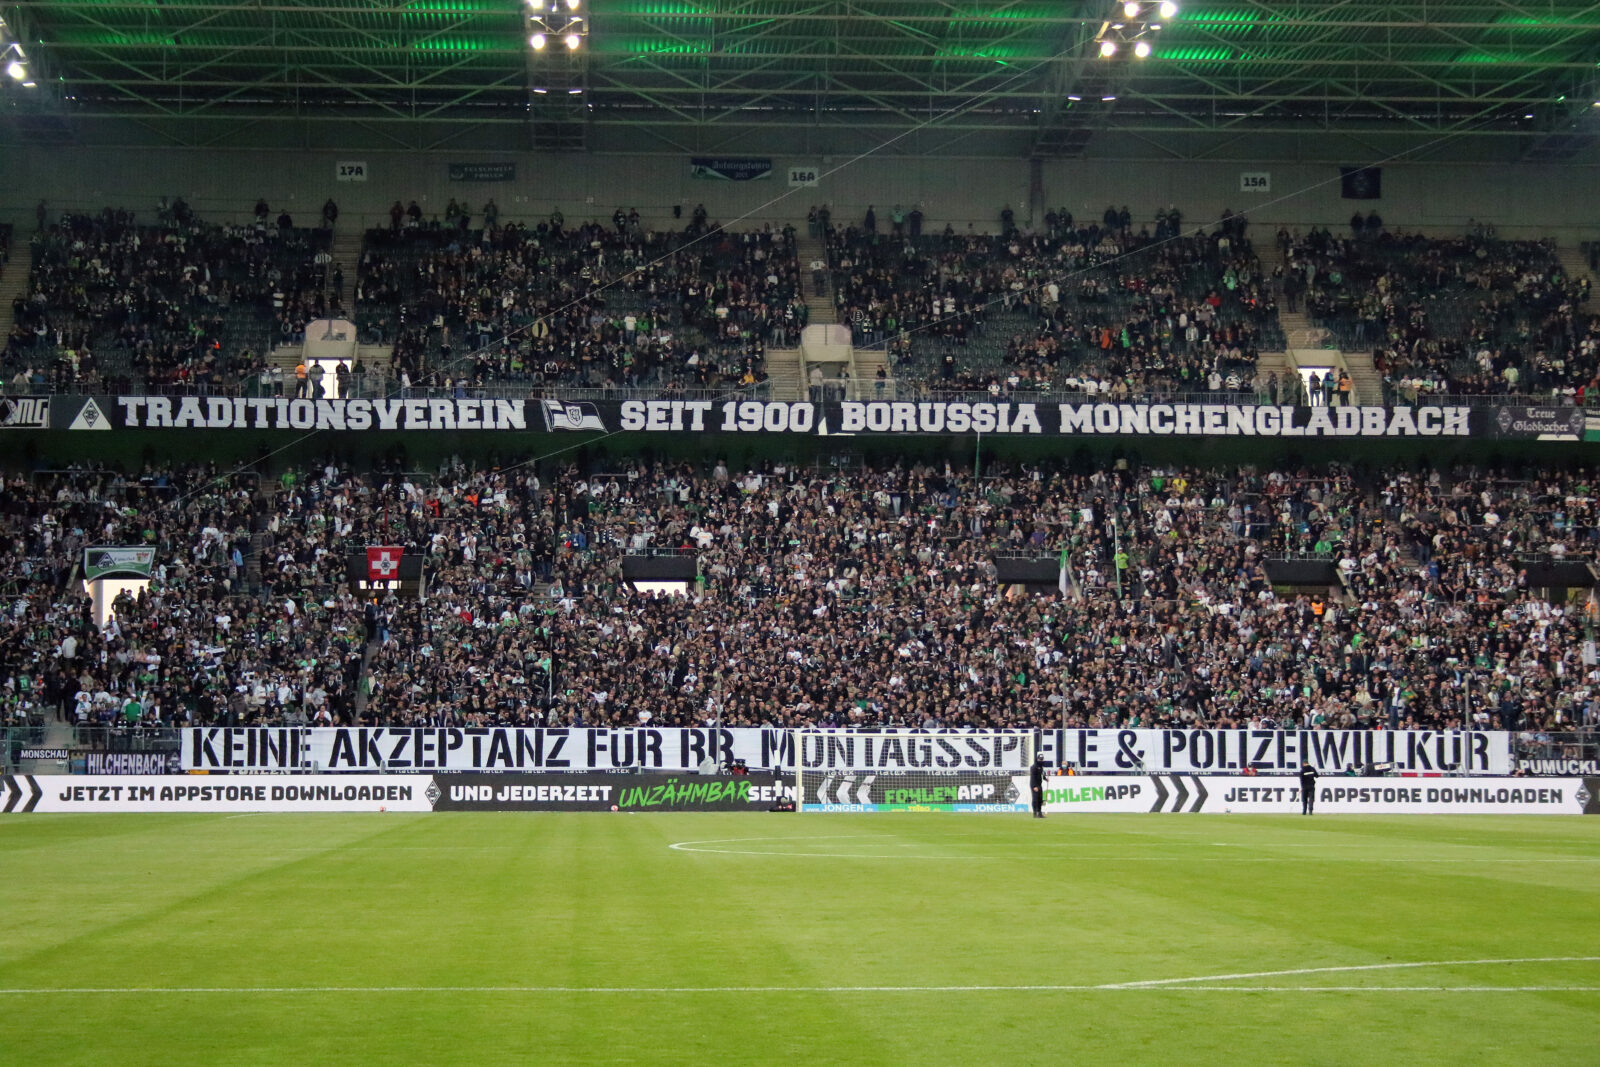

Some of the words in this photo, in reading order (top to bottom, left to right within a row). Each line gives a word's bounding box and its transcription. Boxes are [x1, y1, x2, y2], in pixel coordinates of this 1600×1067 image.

[339, 166, 364, 177] 17A
[791, 171, 815, 182] 16A
[1243, 177, 1267, 187] 15A
[118, 396, 527, 430] TRADITIONSVEREIN
[620, 401, 712, 431] SEIT
[721, 401, 814, 433] 1900
[841, 402, 1042, 434] BORUSSIA
[1526, 407, 1556, 419] Treue
[1512, 420, 1569, 434] Gladbacher
[20, 749, 68, 760] MONSCHAU
[193, 728, 312, 767] KEINE
[328, 728, 571, 768] AKZEPTANZ
[587, 727, 663, 767] FÜR
[761, 728, 1099, 768] MONTAGSSPIELE
[1115, 730, 1145, 768] &
[1163, 730, 1489, 771] POLIZEIWILLKÜR
[87, 753, 166, 775] HILCHENBACH
[59, 785, 123, 802] JETZT
[127, 785, 155, 801] IM
[160, 785, 266, 801] APPSTORE
[271, 785, 412, 801] DOWNLOADEN
[450, 785, 493, 801] UND
[496, 785, 612, 801] JEDERZEIT
[619, 778, 751, 808] UNZÄHMBAR
[1224, 787, 1285, 803] JETZT
[1320, 787, 1422, 803] APPSTORE
[1427, 788, 1563, 804] DOWNLOADEN
[822, 804, 864, 812] JONGEN
[974, 804, 1015, 812] JONGEN
